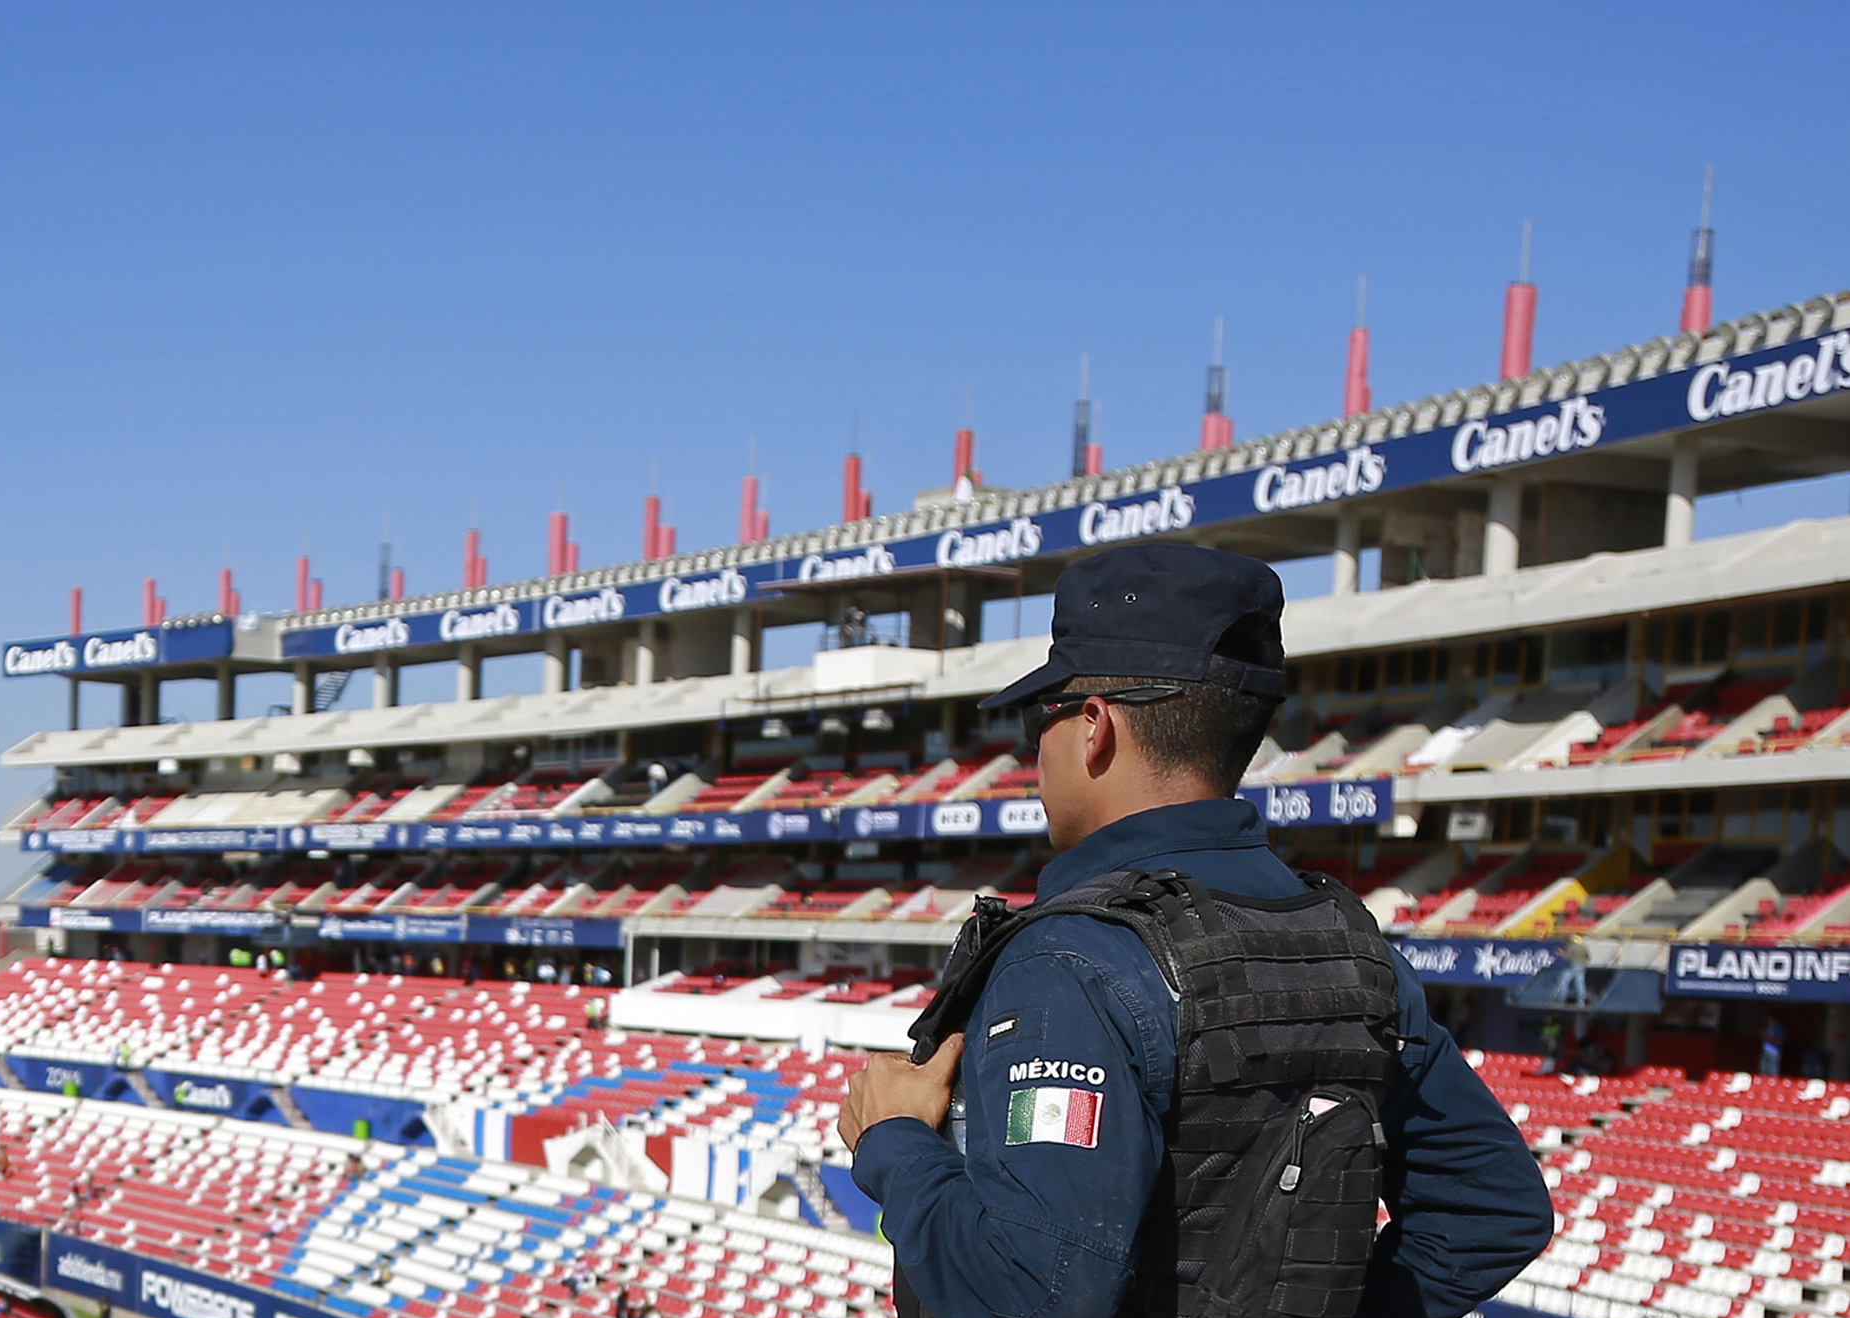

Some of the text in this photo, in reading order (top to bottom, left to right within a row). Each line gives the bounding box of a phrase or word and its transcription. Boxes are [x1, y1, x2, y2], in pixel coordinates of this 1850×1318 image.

[1451, 395, 1607, 474] Canel's
[1253, 445, 1386, 513] Canel's
[1079, 485, 1196, 546] Canel's
[936, 516, 1044, 567] Canel's
[799, 544, 896, 583] Canel's
[544, 585, 626, 628] Canel's
[659, 567, 747, 612] Canel's
[335, 618, 409, 654] Canel's
[440, 603, 519, 641] Canel's
[6, 640, 77, 675] Canel's
[84, 631, 157, 668] Canel's
[1676, 949, 1792, 981] PLANO
[1010, 1057, 1106, 1085] MÉXICO
